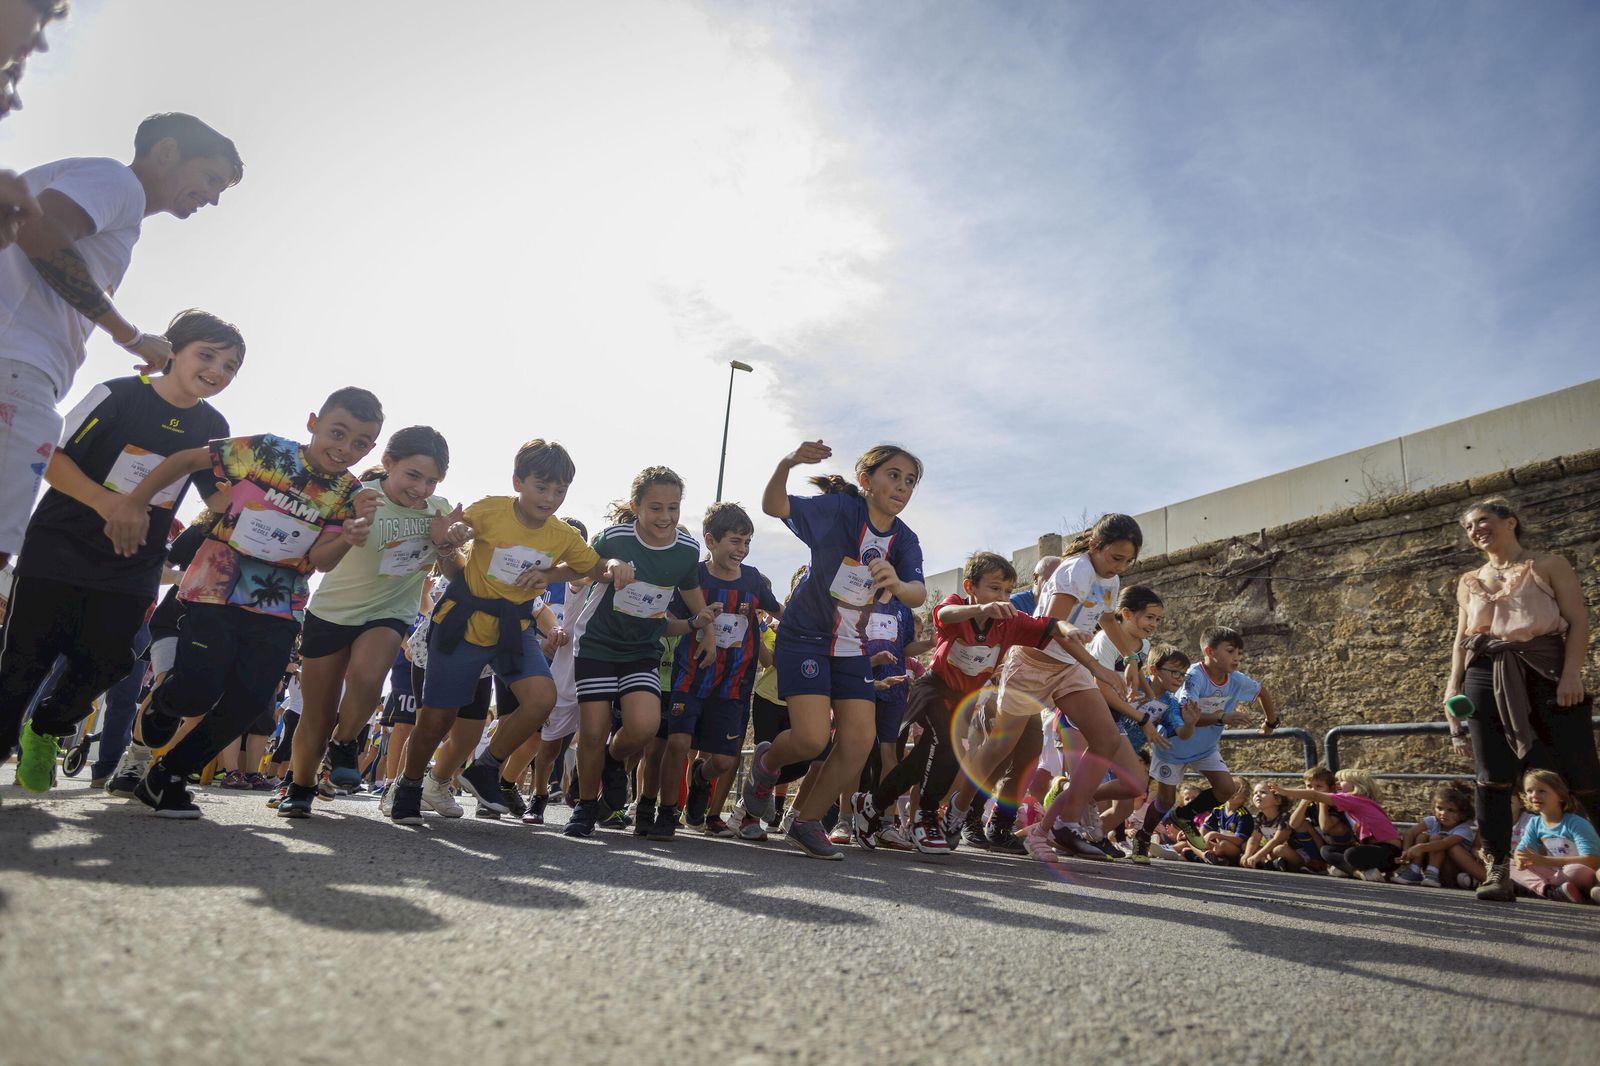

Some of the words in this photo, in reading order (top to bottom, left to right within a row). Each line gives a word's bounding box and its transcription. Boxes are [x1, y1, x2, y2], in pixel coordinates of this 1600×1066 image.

[264, 487, 320, 523] MIAMI
[377, 517, 400, 552] LOS
[403, 516, 433, 538] ANGE
[398, 694, 417, 713] 10
[928, 744, 936, 759] YORK
